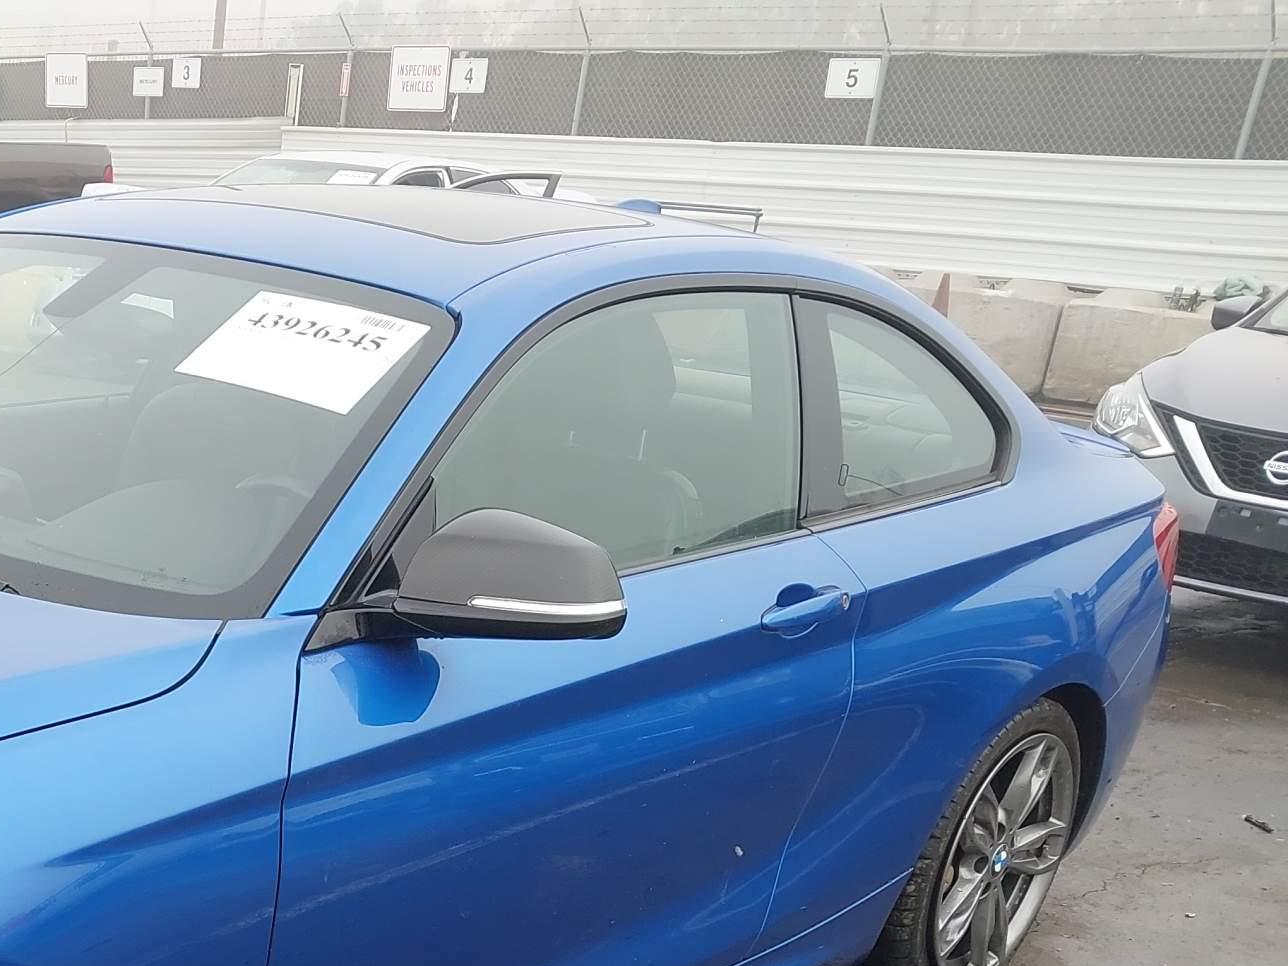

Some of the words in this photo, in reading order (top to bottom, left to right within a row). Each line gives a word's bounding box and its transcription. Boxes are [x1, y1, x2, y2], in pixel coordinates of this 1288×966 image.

[183, 65, 190, 80] 3
[397, 64, 442, 77] INSPECTIONS
[464, 67, 474, 84] 4
[845, 68, 859, 88] 5
[54, 75, 78, 86] MERCURY
[401, 80, 434, 93] VEHICLES
[248, 311, 388, 352] 43926245
